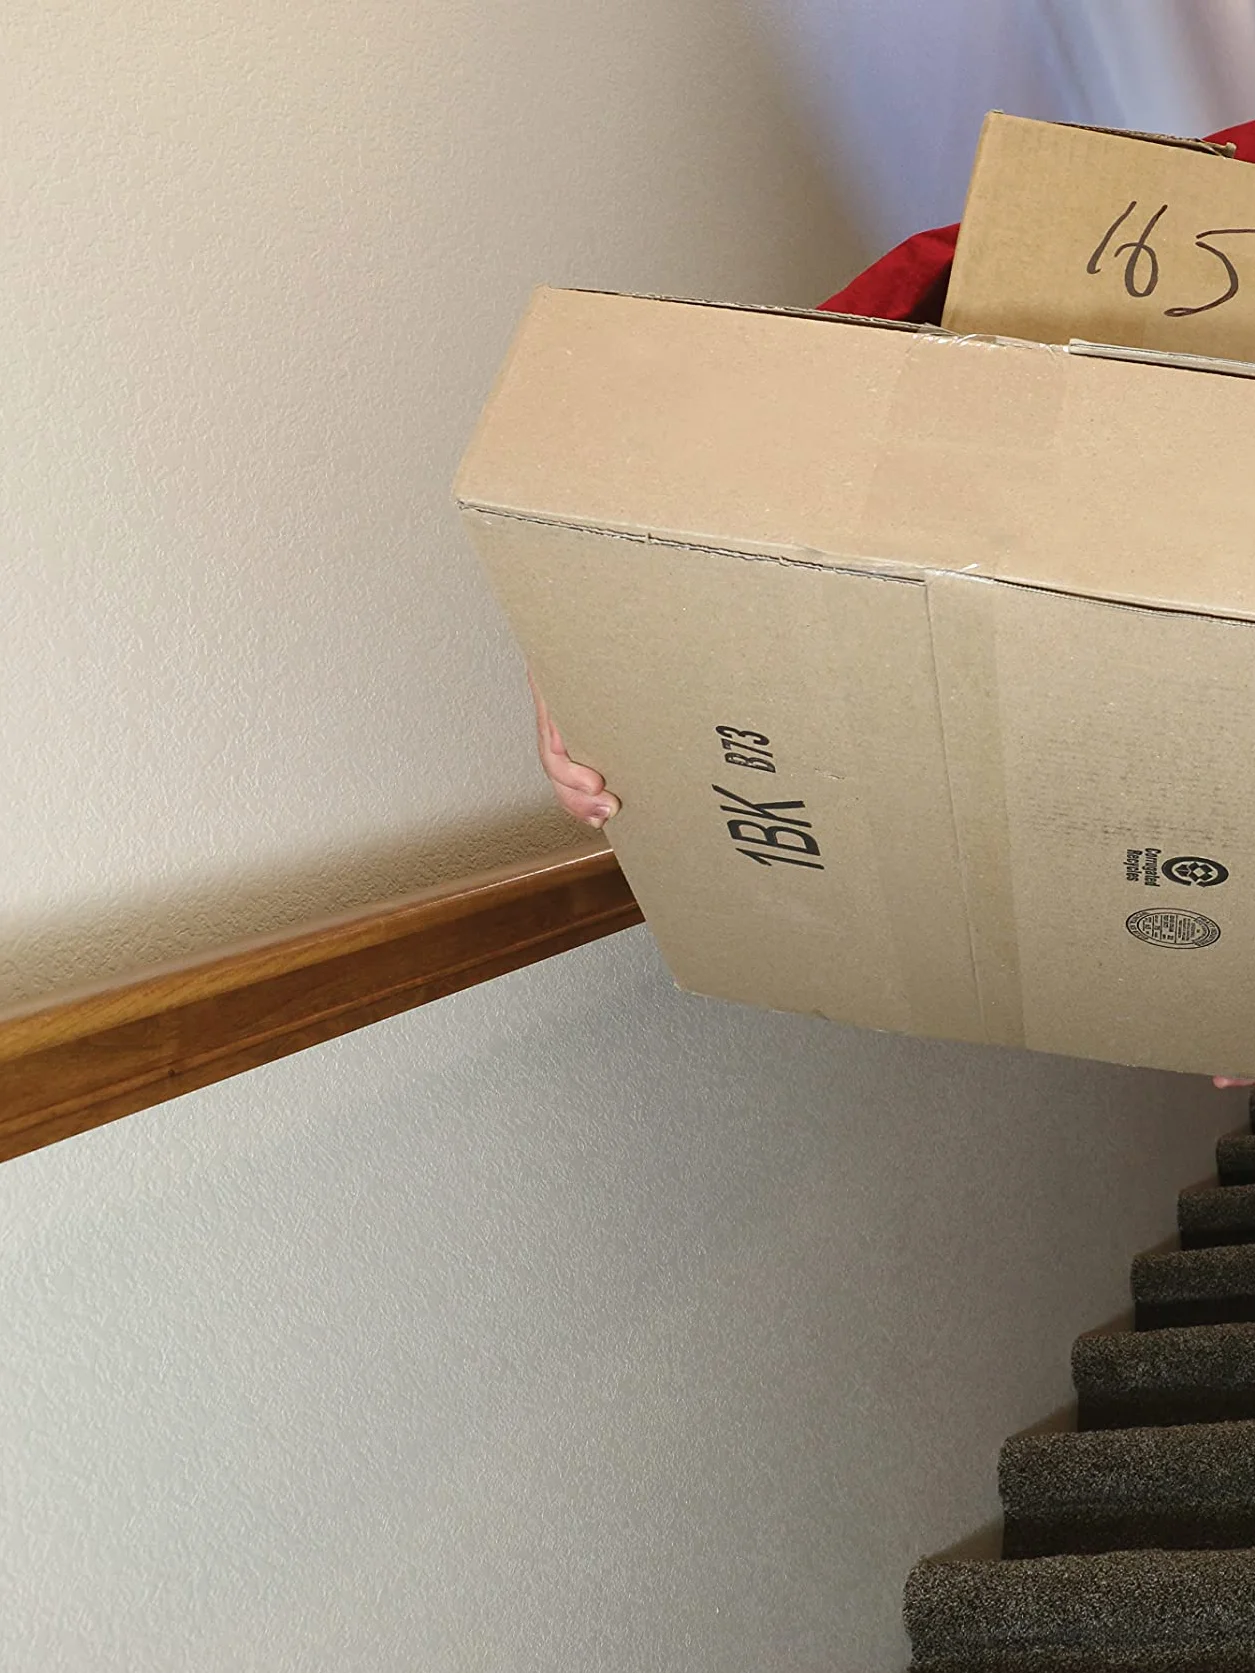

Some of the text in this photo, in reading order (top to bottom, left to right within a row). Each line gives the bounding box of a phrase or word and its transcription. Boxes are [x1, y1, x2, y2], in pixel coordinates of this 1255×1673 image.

[711, 725, 825, 870] 1BK B73
[1123, 849, 1142, 882] Recycles
[1142, 847, 1161, 887] Corrugated
